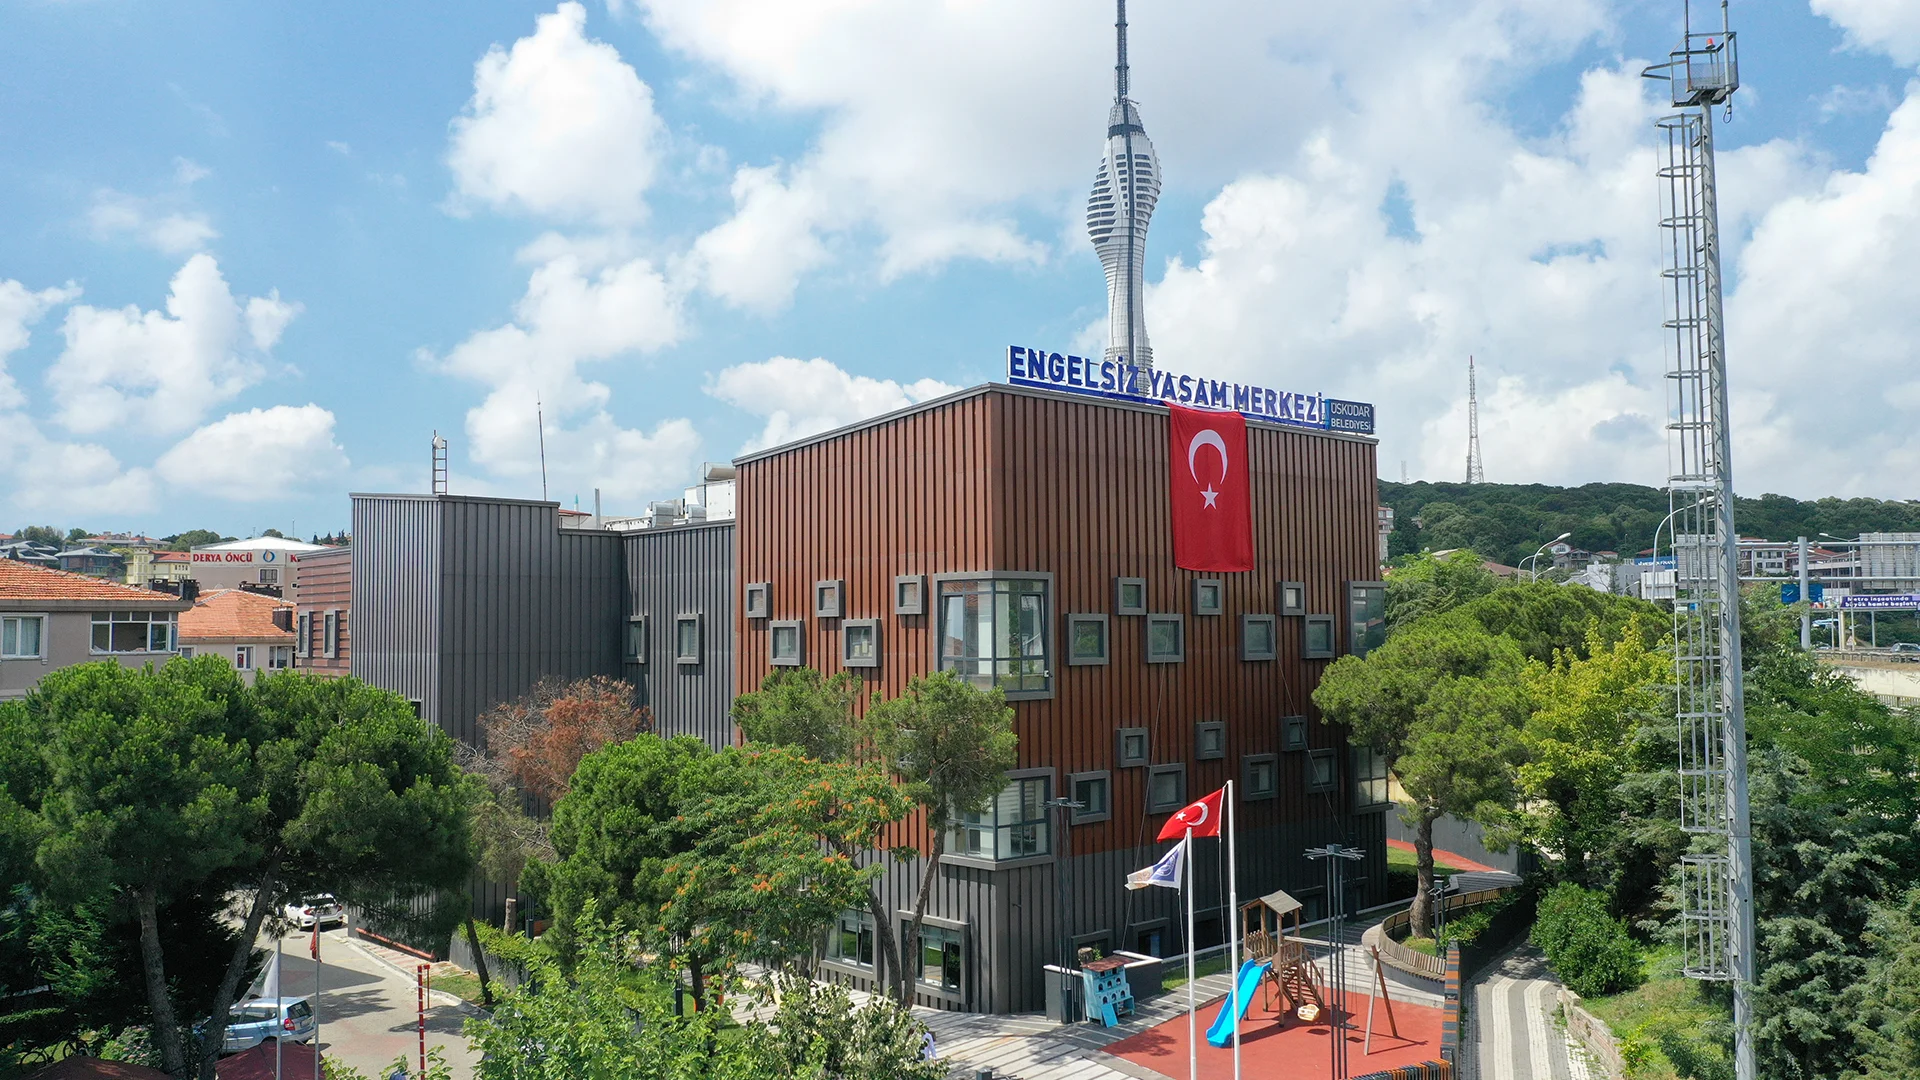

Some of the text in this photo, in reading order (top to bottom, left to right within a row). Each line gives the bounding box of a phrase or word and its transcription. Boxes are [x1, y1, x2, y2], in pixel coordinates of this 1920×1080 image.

[1008, 345, 1139, 394] ENGELSİZ
[1233, 383, 1322, 422] MERKEZİ
[1331, 418, 1371, 430] BELEDİYESİ
[193, 554, 222, 562] DERYA
[225, 552, 253, 562] ÖNCÜ
